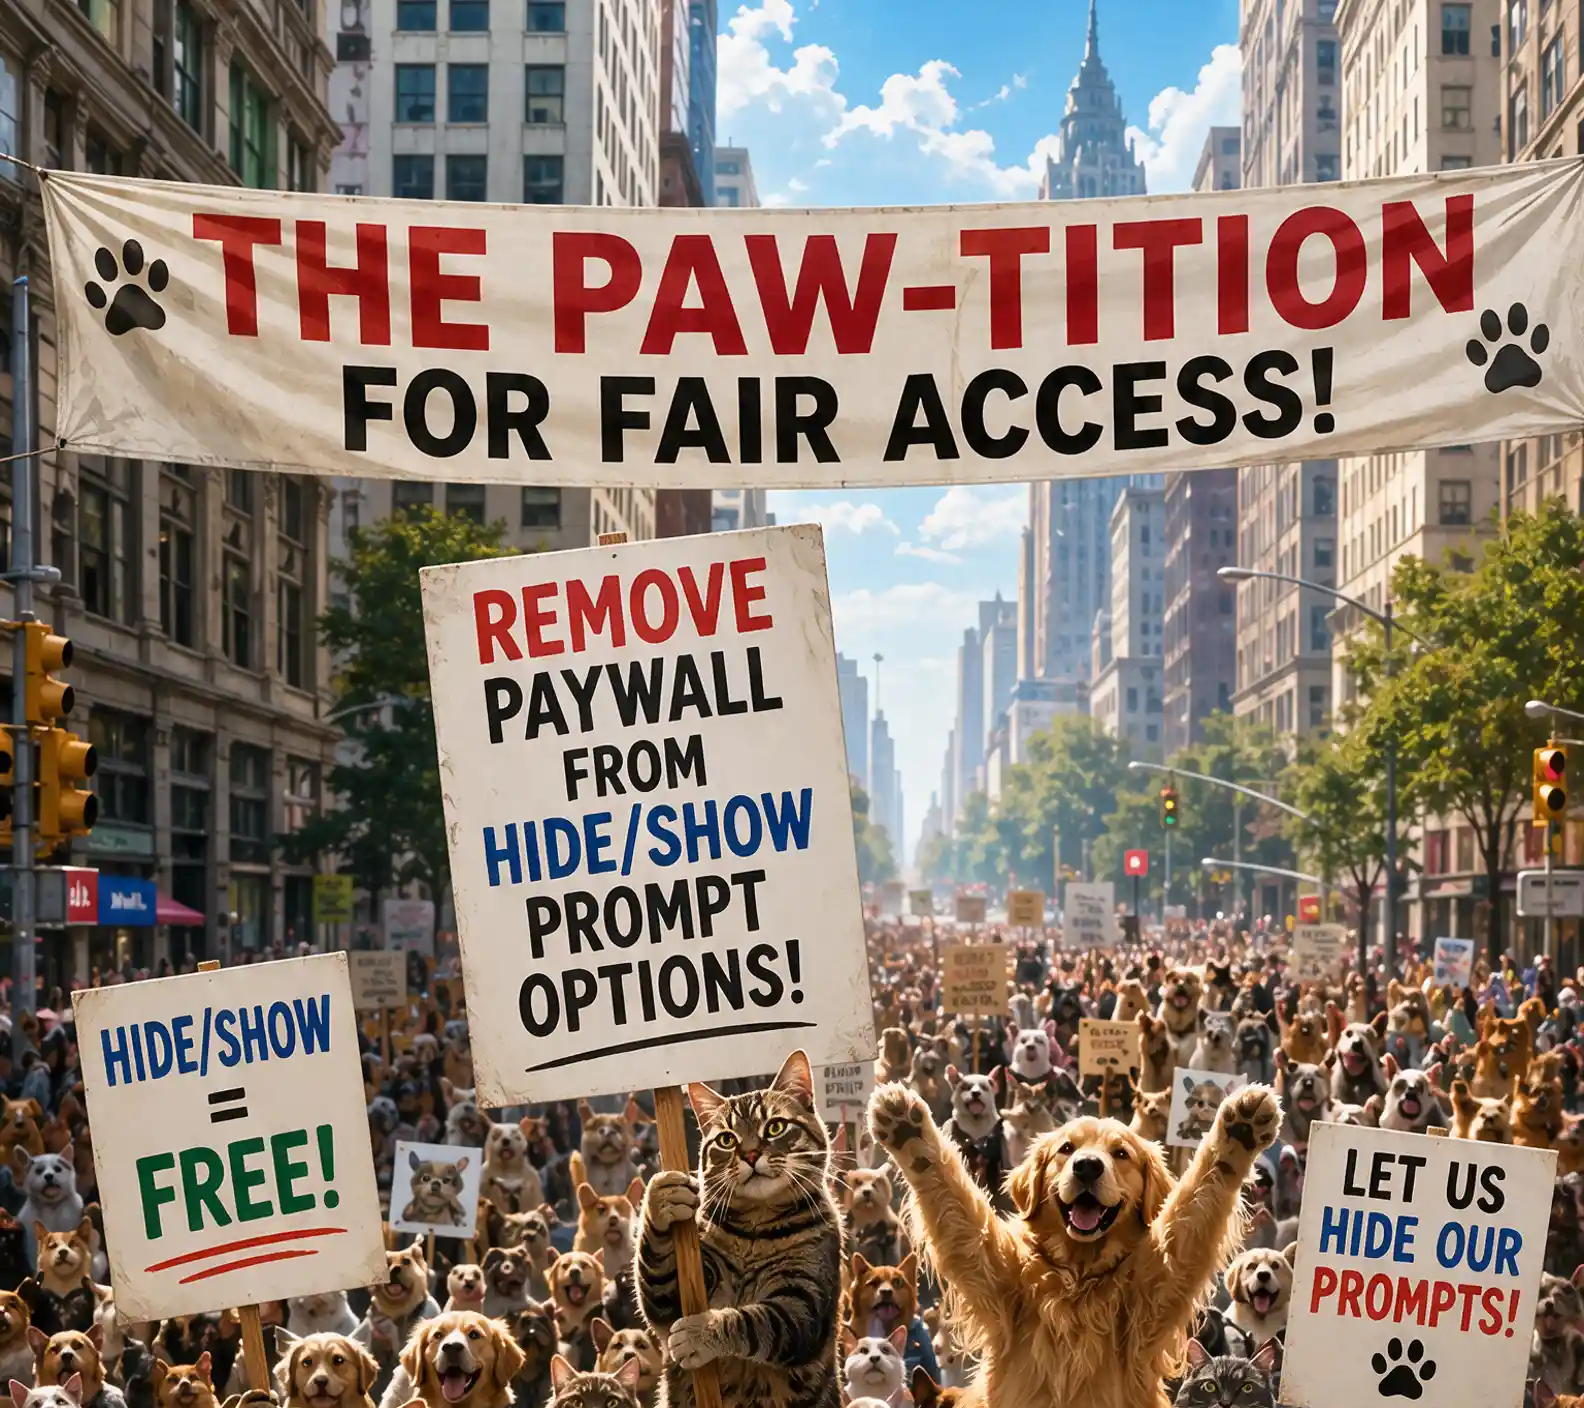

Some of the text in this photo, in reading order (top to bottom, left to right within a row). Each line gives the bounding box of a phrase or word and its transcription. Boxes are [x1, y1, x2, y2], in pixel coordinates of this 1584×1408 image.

[193, 194, 1474, 355] THE PAW-TITION
[343, 347, 1334, 463] FOR FAIR ACCESS!
[473, 557, 773, 664] REMOVE
[484, 647, 783, 744] PAYWALL
[563, 734, 707, 801] FROM
[483, 788, 812, 886] HIDE/SHOW
[526, 870, 766, 959] PROMPT
[519, 939, 803, 1037] OPTIONS!
[101, 995, 330, 1087] HIDE/SHOW
[208, 1087, 248, 1123] =
[136, 1124, 339, 1240] FREE!
[1343, 1149, 1505, 1213] LET US
[1319, 1206, 1522, 1276] HIDE OUR
[1310, 1267, 1520, 1338] PROMPTS!
